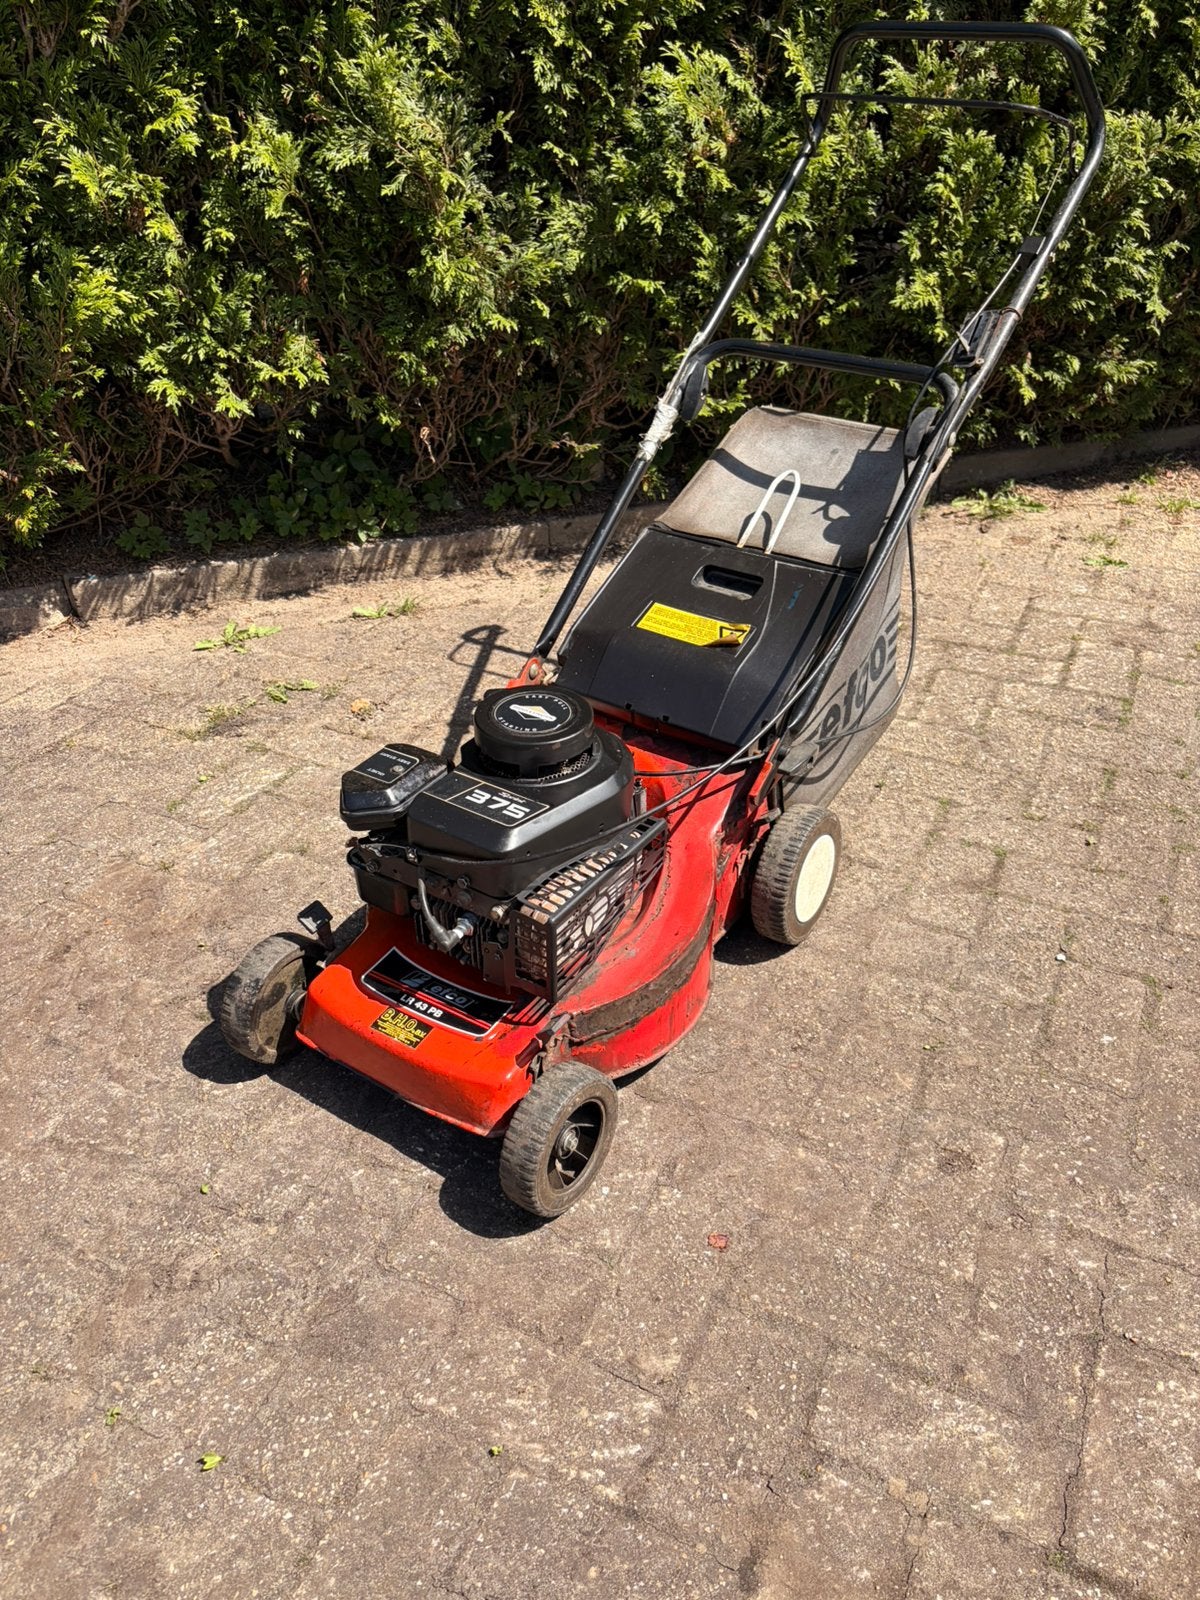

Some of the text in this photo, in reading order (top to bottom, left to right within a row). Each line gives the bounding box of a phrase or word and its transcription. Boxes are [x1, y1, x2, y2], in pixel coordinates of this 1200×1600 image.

[465, 789, 531, 819] 375
[400, 994, 444, 1018] LR 43 PB
[430, 985, 468, 1004] efco
